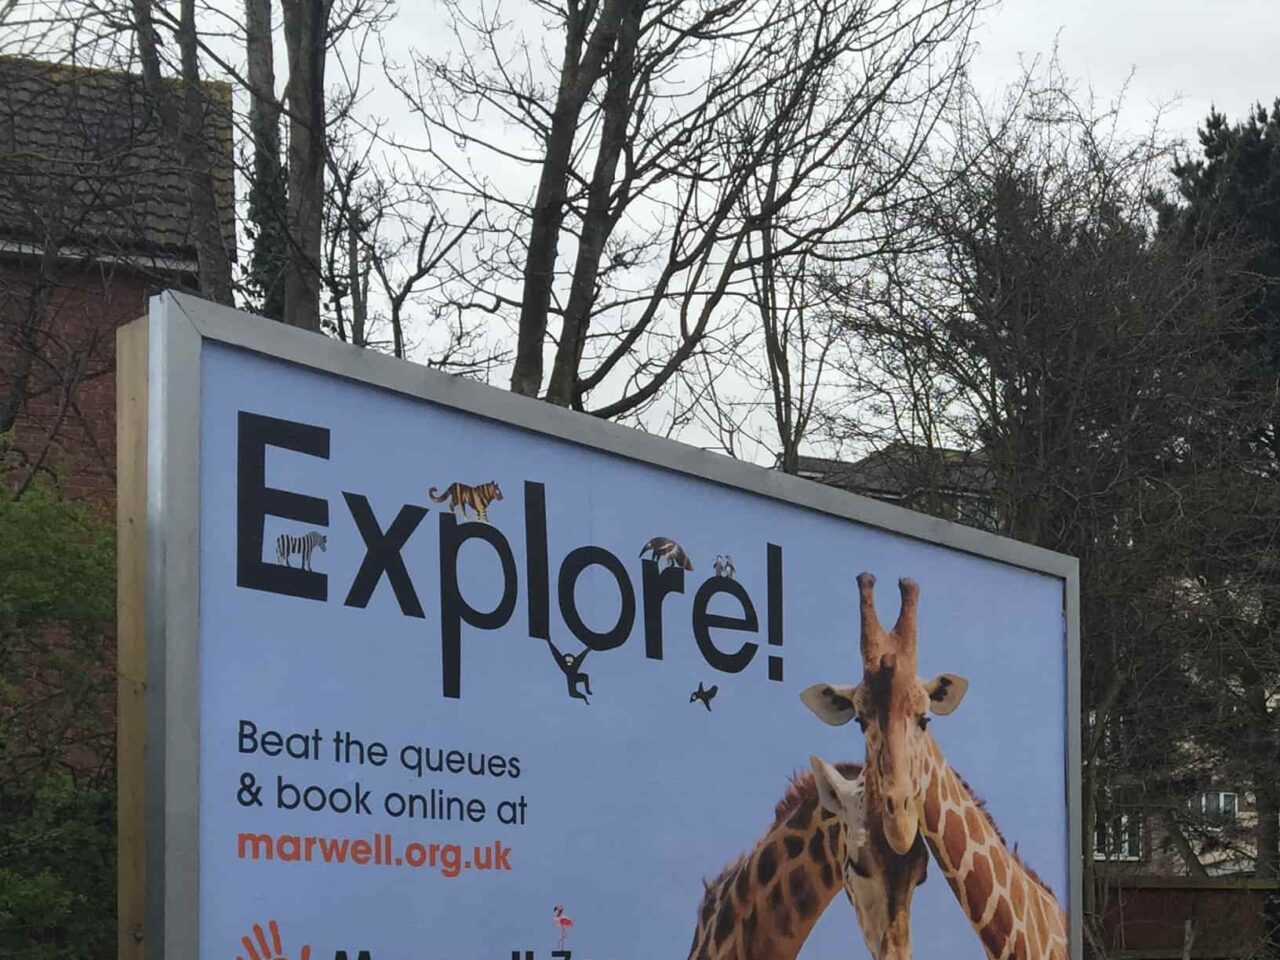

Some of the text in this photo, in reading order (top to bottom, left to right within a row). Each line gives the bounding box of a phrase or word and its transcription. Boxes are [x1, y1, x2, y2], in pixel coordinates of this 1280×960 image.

[237, 410, 784, 698] Explore!
[238, 720, 521, 778] Beat the queues
[237, 772, 528, 826] & book online at
[238, 833, 512, 878] marwell.org.uk
